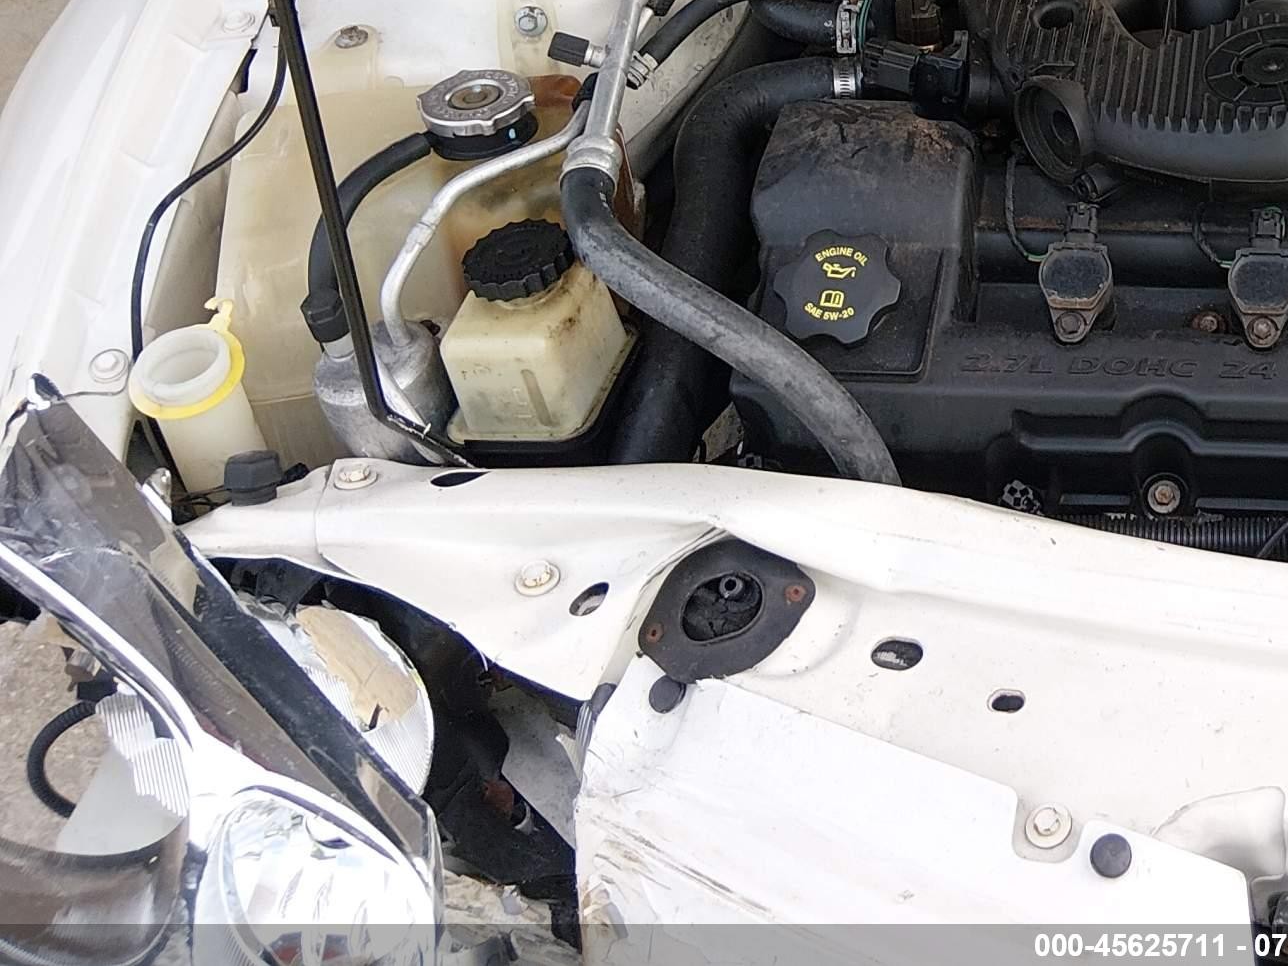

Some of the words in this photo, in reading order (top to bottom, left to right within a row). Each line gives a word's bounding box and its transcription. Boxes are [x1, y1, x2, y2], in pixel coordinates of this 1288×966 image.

[815, 246, 854, 262] ENGINE
[853, 251, 868, 266] OIL
[804, 302, 823, 319] SAE
[823, 307, 855, 321] 5W-20
[960, 352, 1053, 375] 2.7L
[1067, 355, 1200, 378] DOHC
[1218, 359, 1279, 381] 24
